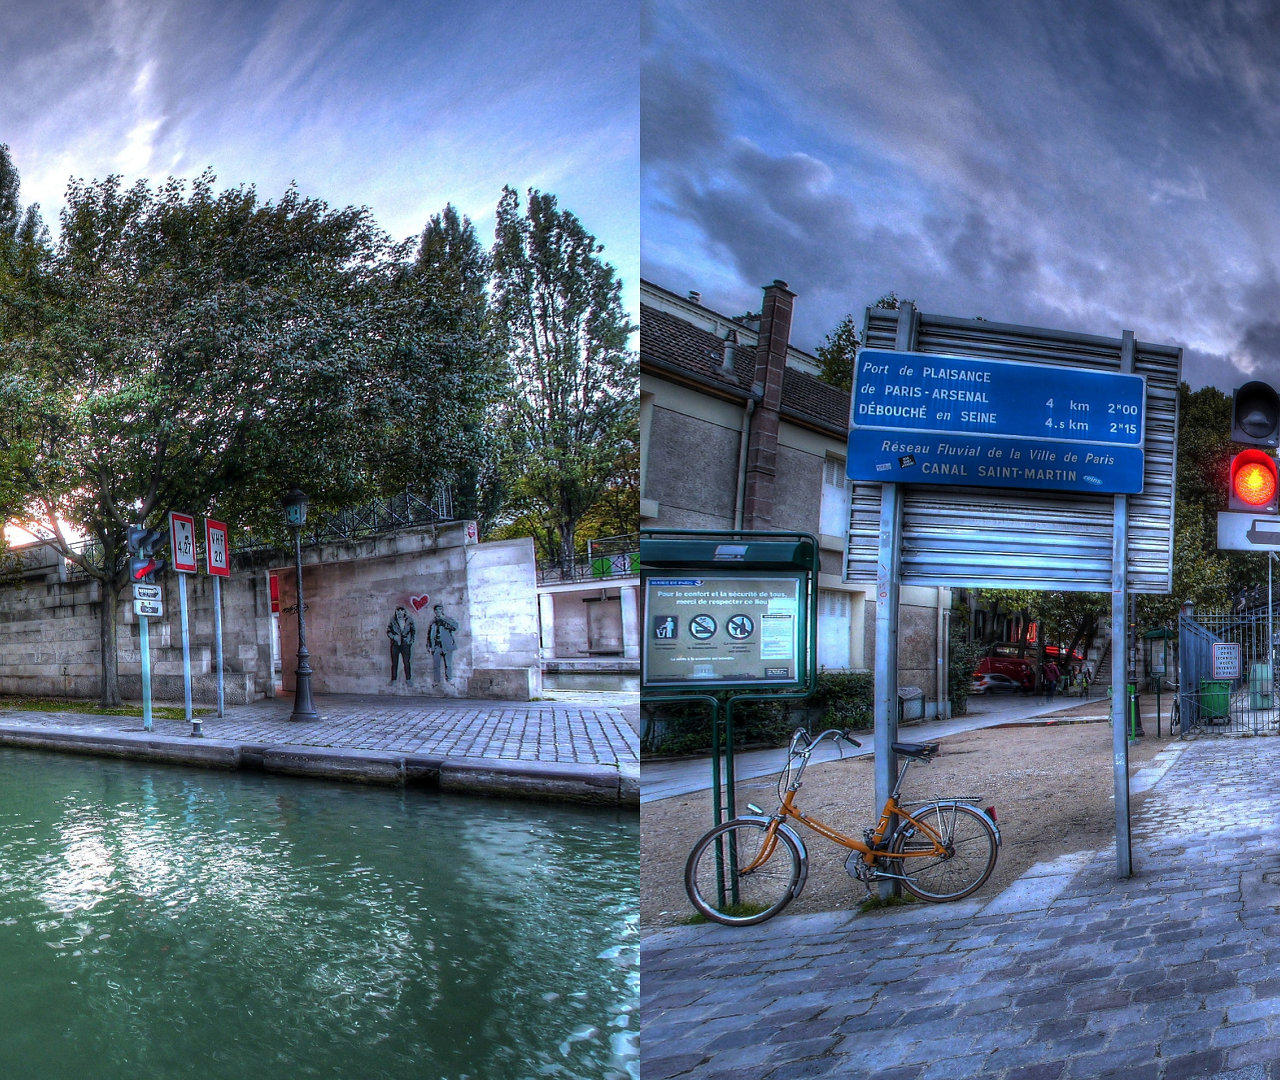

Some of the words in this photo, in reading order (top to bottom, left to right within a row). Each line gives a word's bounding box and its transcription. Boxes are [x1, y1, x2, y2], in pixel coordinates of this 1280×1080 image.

[863, 362, 889, 374] Port
[899, 365, 914, 376] de
[923, 367, 991, 383] PLAISANCE
[861, 383, 876, 394] de
[1046, 398, 1054, 408] 4
[1070, 400, 1090, 411] km
[859, 401, 927, 419] DÉBOUCHÉ
[936, 412, 951, 420] en
[961, 411, 997, 424] SEINE
[1069, 419, 1089, 431] km
[881, 440, 930, 454] Réseau
[937, 443, 980, 457] Fluvial
[987, 447, 1003, 458] de
[1010, 448, 1021, 459] la
[1030, 450, 1056, 461] Ville
[1064, 452, 1078, 462] de
[1085, 453, 1115, 465] Paris
[922, 462, 968, 476] CANAL
[978, 465, 1077, 481] SAINT-MARTIN
[211, 532, 223, 546] VHF
[214, 551, 222, 563] 20
